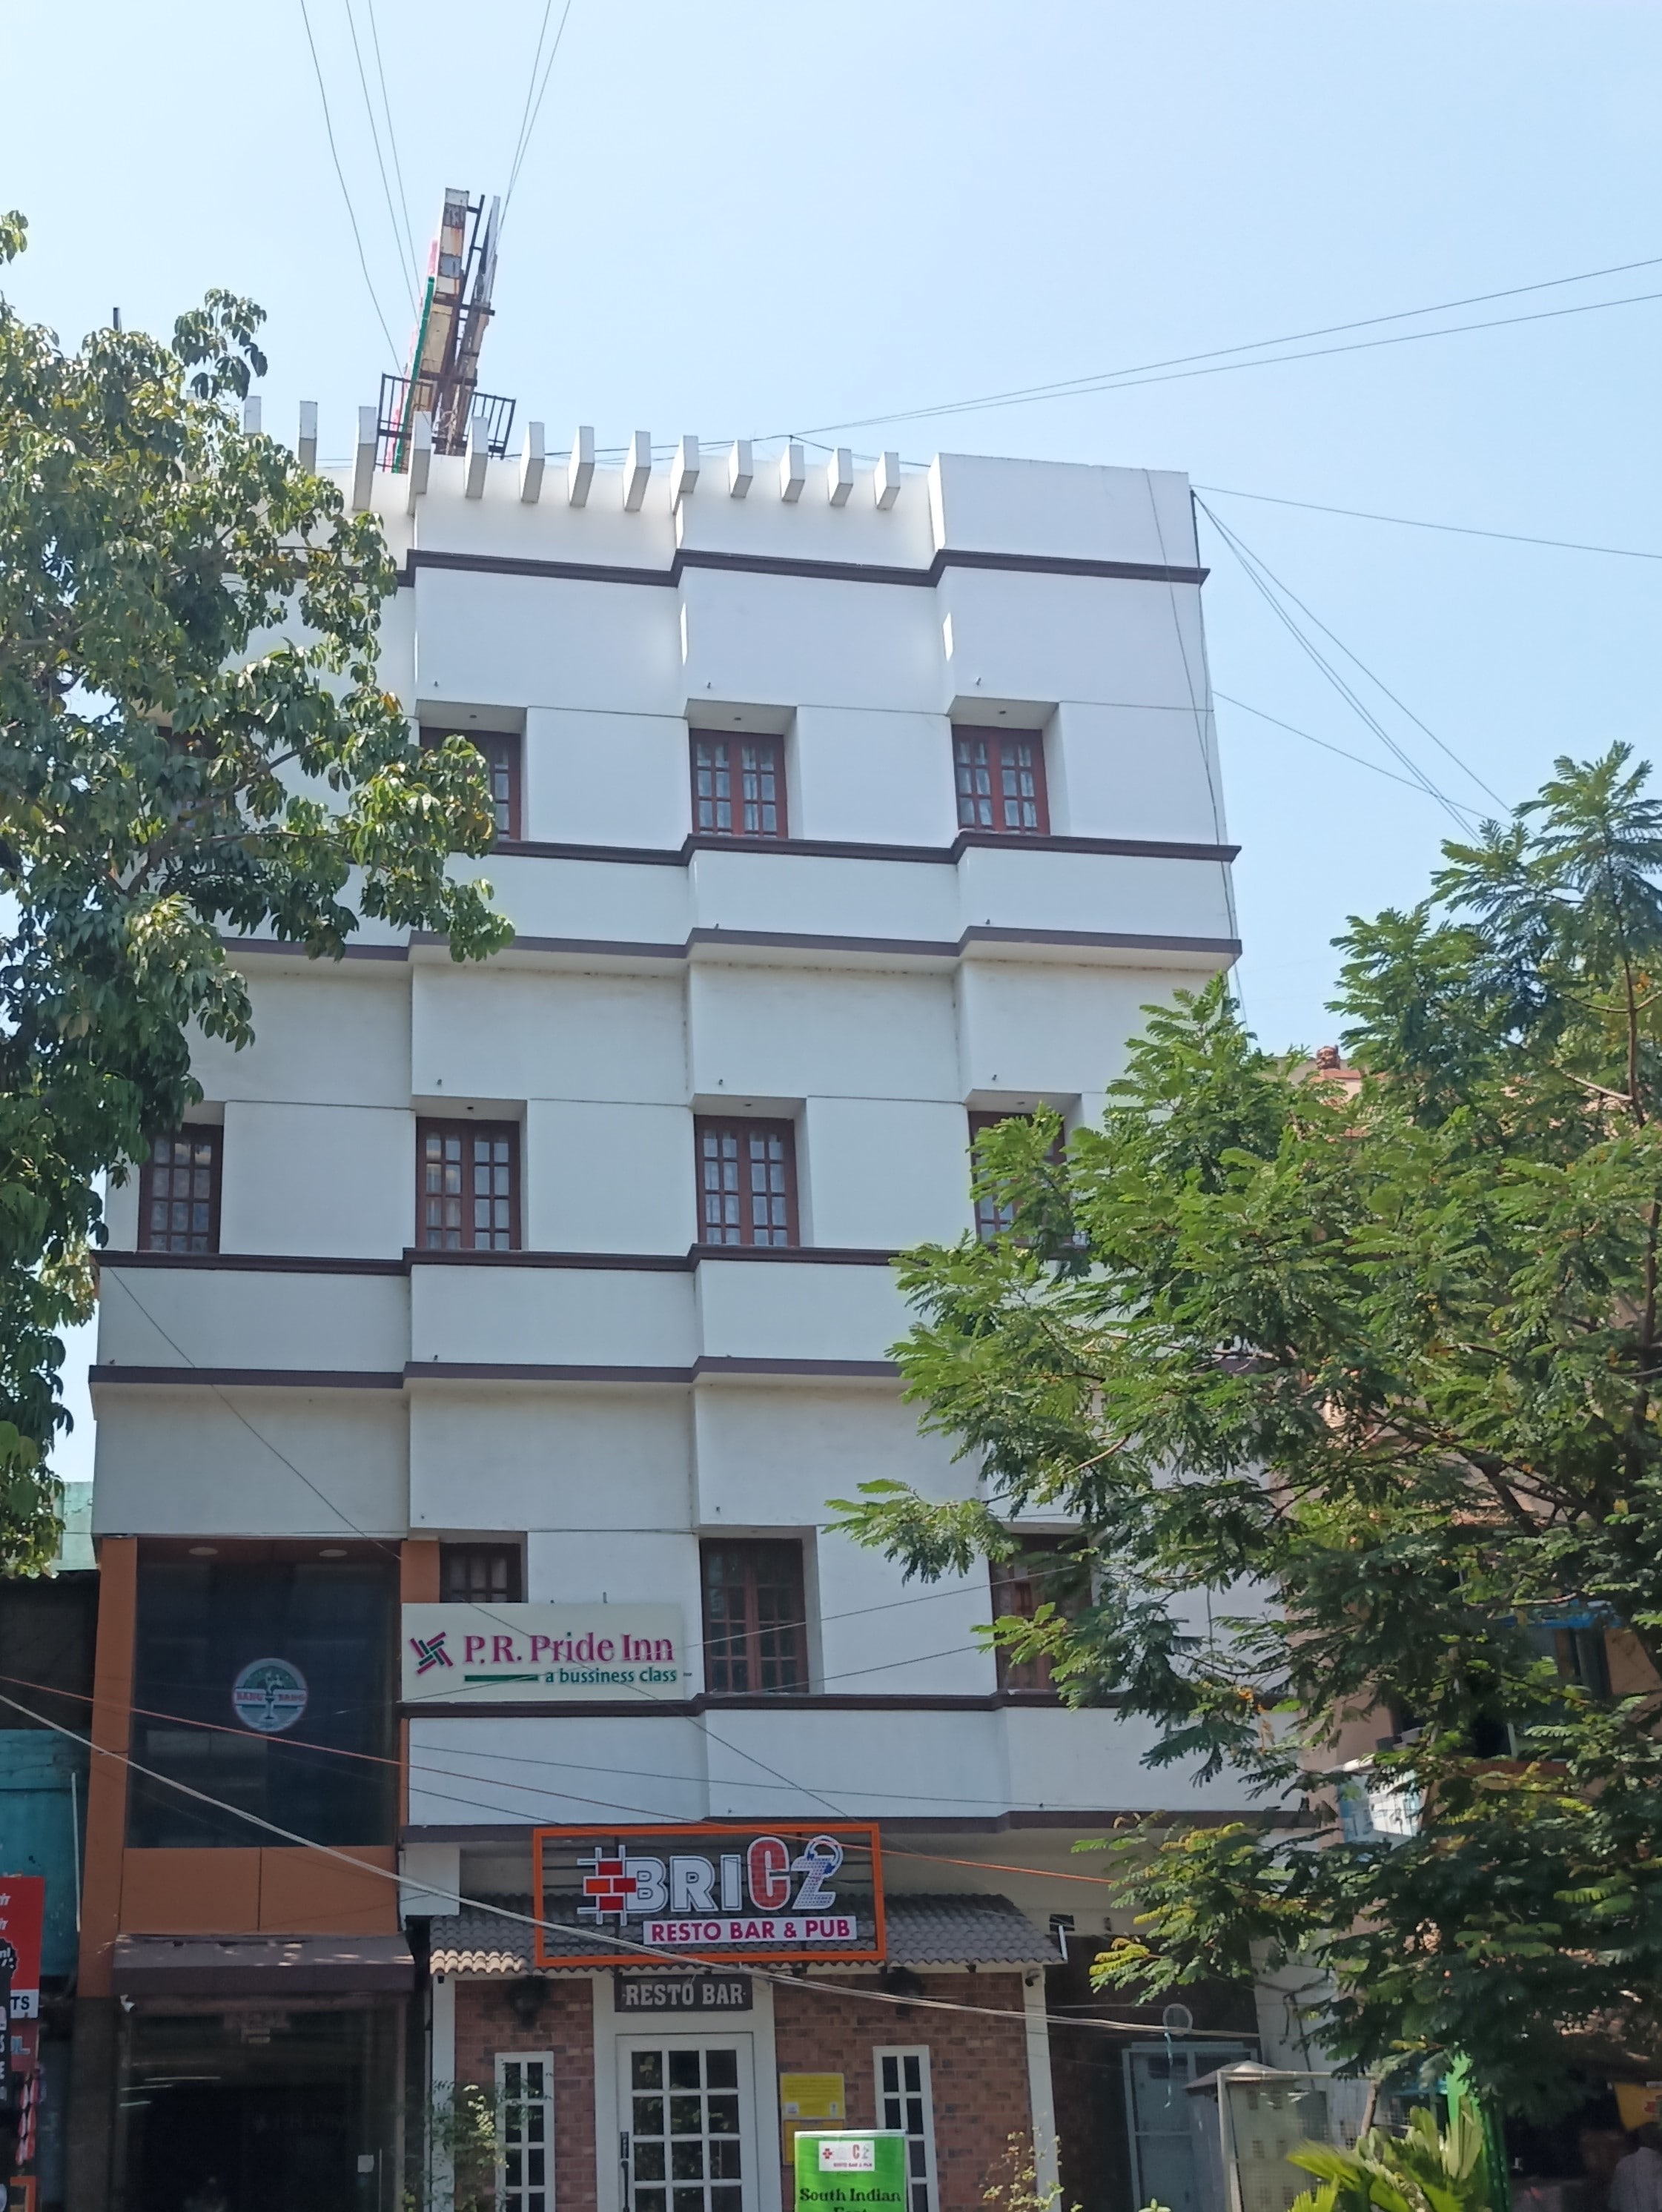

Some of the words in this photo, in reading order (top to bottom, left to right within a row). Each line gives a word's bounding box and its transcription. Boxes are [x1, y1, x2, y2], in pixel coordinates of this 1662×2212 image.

[529, 1632, 615, 1663] Pride
[620, 1634, 675, 1661] Inn
[545, 1672, 554, 1683] a
[560, 1668, 635, 1683] bussiness
[639, 1667, 677, 1682] class
[652, 1922, 721, 1942] RESTO
[730, 1920, 775, 1939] BAR
[784, 1921, 797, 1938] &
[805, 1919, 850, 1938] PUB
[626, 1984, 694, 2005] RESTO
[702, 1984, 744, 2004] BAR
[799, 2188, 846, 2202] South
[850, 2188, 901, 2202] Indian
